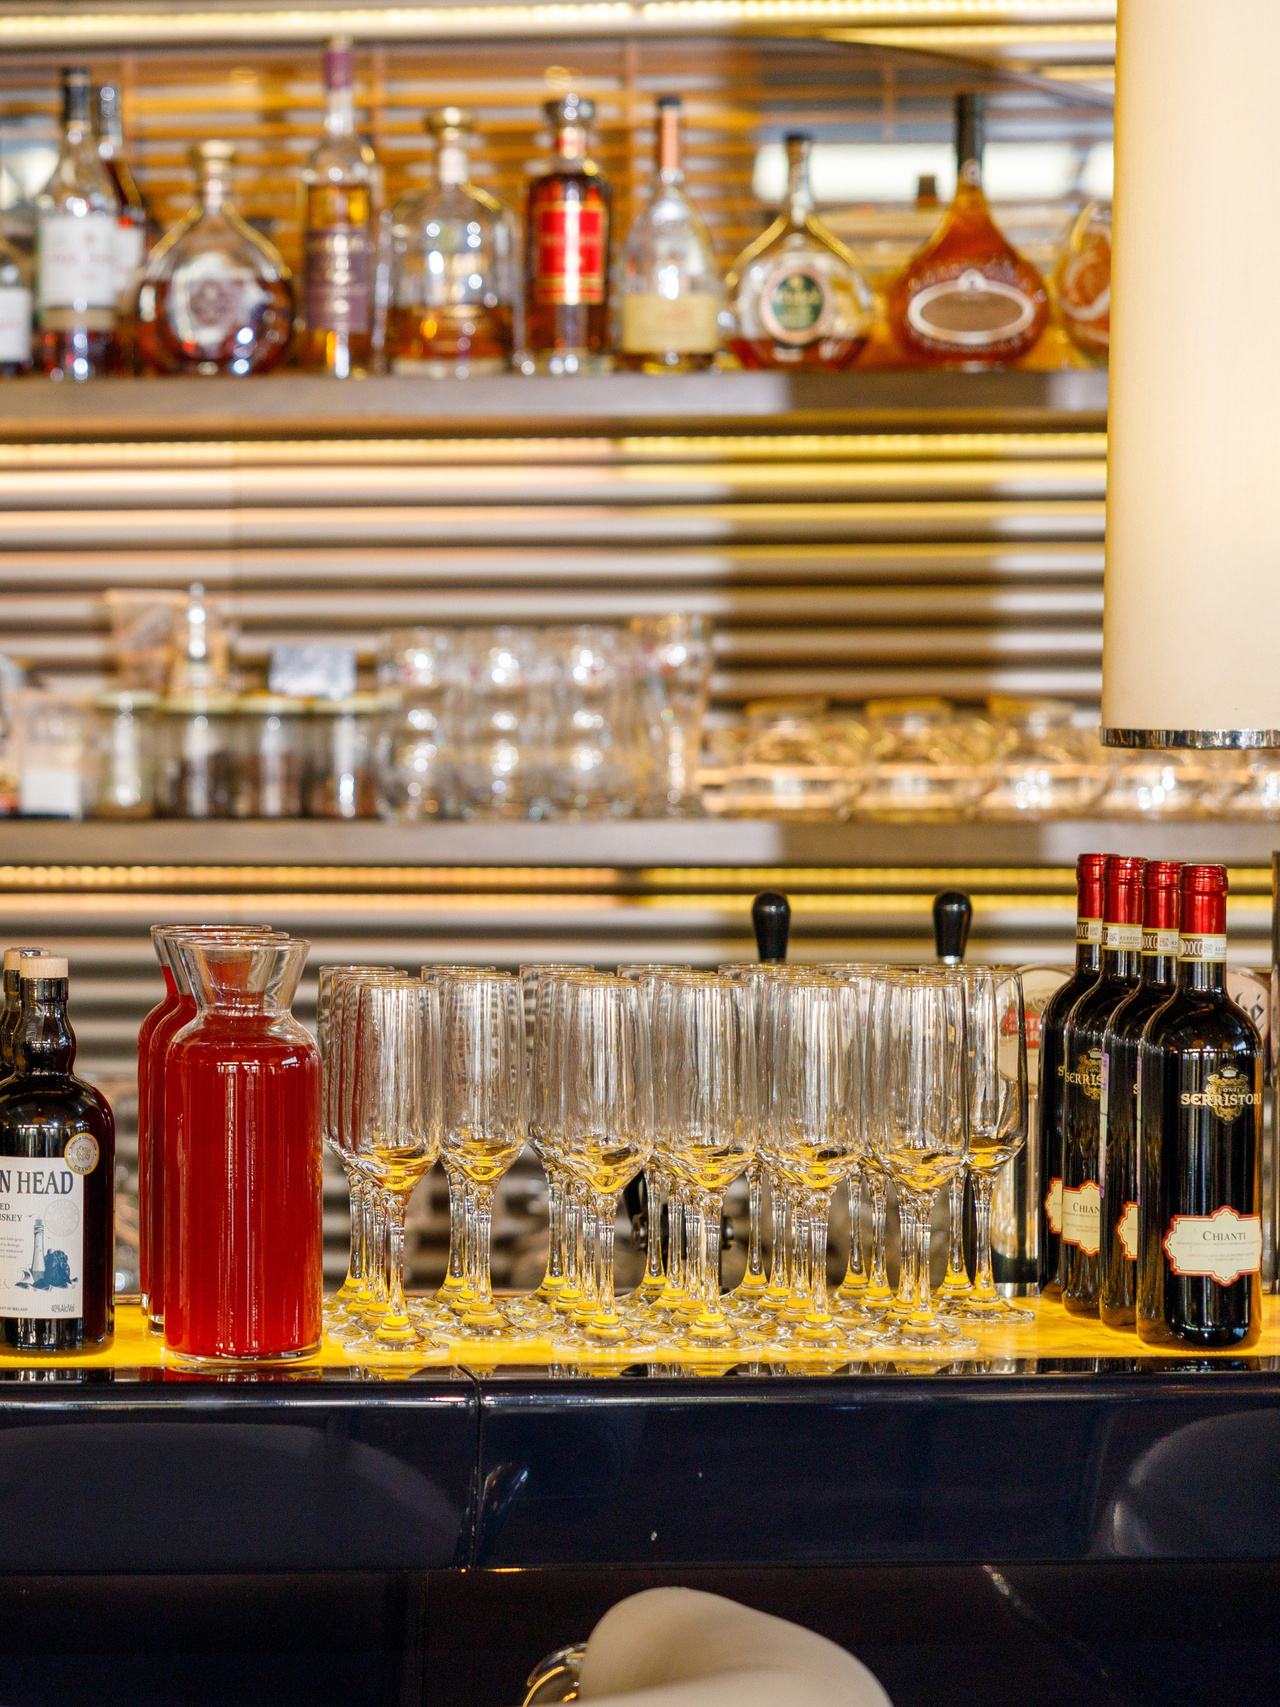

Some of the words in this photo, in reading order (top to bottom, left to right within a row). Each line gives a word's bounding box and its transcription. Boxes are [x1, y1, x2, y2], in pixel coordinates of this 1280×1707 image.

[1065, 1072, 1102, 1086] SERRIS
[73, 1164, 93, 1172] GRAND
[16, 1170, 74, 1195] HEAD
